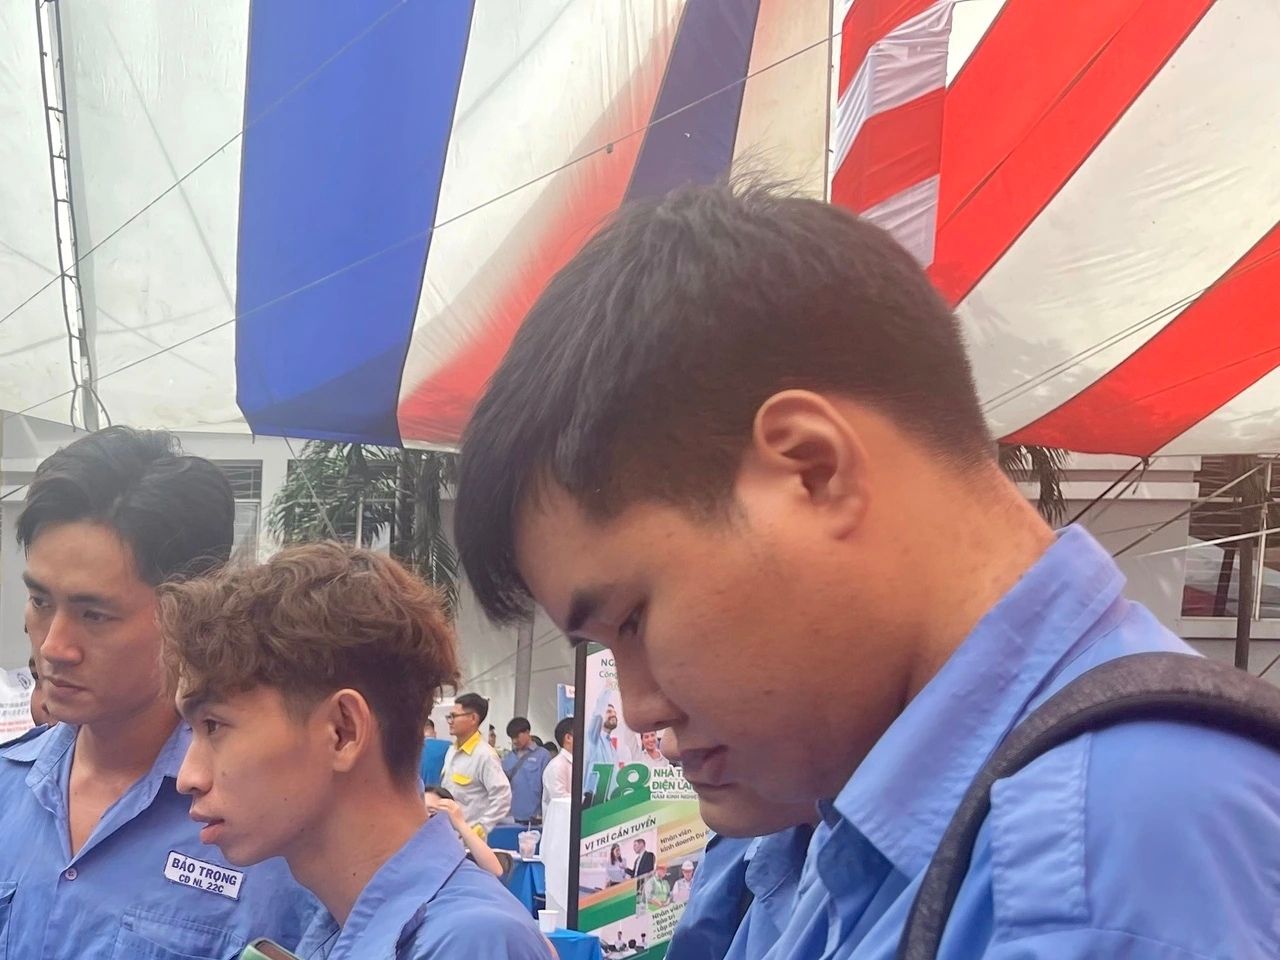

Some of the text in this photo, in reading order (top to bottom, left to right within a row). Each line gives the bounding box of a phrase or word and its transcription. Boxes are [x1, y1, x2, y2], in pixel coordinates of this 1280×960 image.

[592, 762, 651, 804] 18
[653, 767, 675, 778] NHÀ
[652, 780, 675, 792] ĐIỆN
[596, 835, 610, 847] TRÍ
[630, 815, 657, 833] TUYỂN
[171, 857, 238, 886] BẢO TRỌNG
[192, 877, 204, 888] NL
[206, 881, 225, 893] 22C
